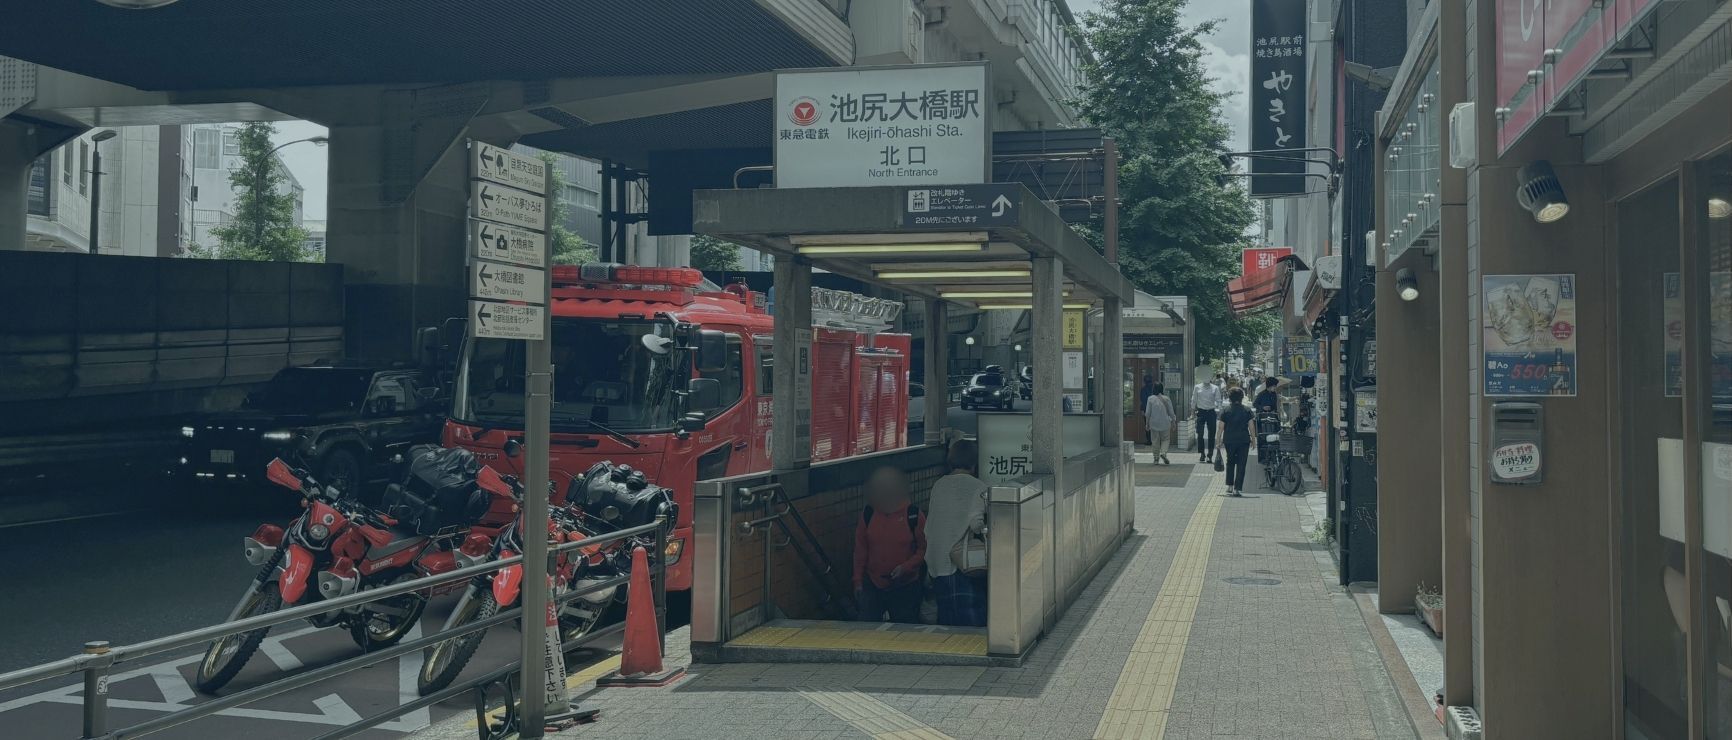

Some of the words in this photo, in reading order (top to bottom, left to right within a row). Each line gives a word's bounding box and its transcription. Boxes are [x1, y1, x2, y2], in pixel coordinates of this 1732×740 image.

[1256, 34, 1303, 47] 池尻駅前
[1256, 47, 1303, 58] 焼き鳥酒場
[829, 89, 979, 123] 池尻大橋駅
[1263, 69, 1293, 147] やきと
[780, 128, 830, 140] 東急電鉄
[847, 126, 932, 142] Ikejiri-ōhashi
[936, 124, 963, 137] Sta.
[880, 145, 926, 166] 北口
[868, 168, 894, 177] North
[897, 167, 938, 177] Entrance
[930, 189, 965, 197] 改札階ゆき
[511, 236, 534, 251] 大橋病院
[1258, 252, 1277, 269] 靴
[494, 269, 525, 285] 大橋図書館
[510, 287, 524, 298] Library
[989, 455, 1032, 475] 池尻
